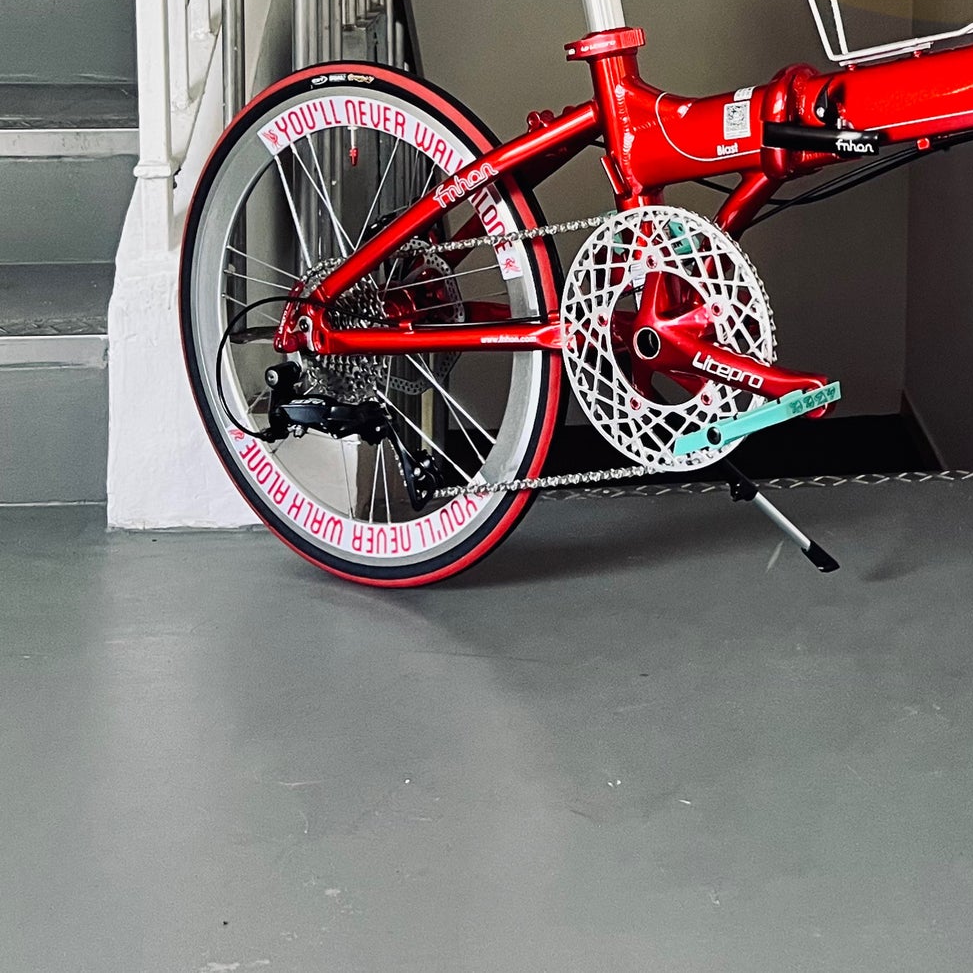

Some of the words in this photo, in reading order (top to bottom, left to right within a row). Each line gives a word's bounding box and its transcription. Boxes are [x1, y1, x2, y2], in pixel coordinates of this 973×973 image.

[716, 142, 739, 157] Blast
[835, 139, 875, 153] fnhon
[274, 100, 342, 142] YOU'LL
[344, 99, 406, 138] NEVER
[471, 190, 512, 254] LONE
[433, 162, 499, 208] fnhon
[692, 351, 764, 389] Litepro
[239, 439, 291, 505] ALONE
[287, 490, 343, 546] WALK
[352, 525, 412, 554] NEVER
[417, 493, 478, 548] YOU'LL
